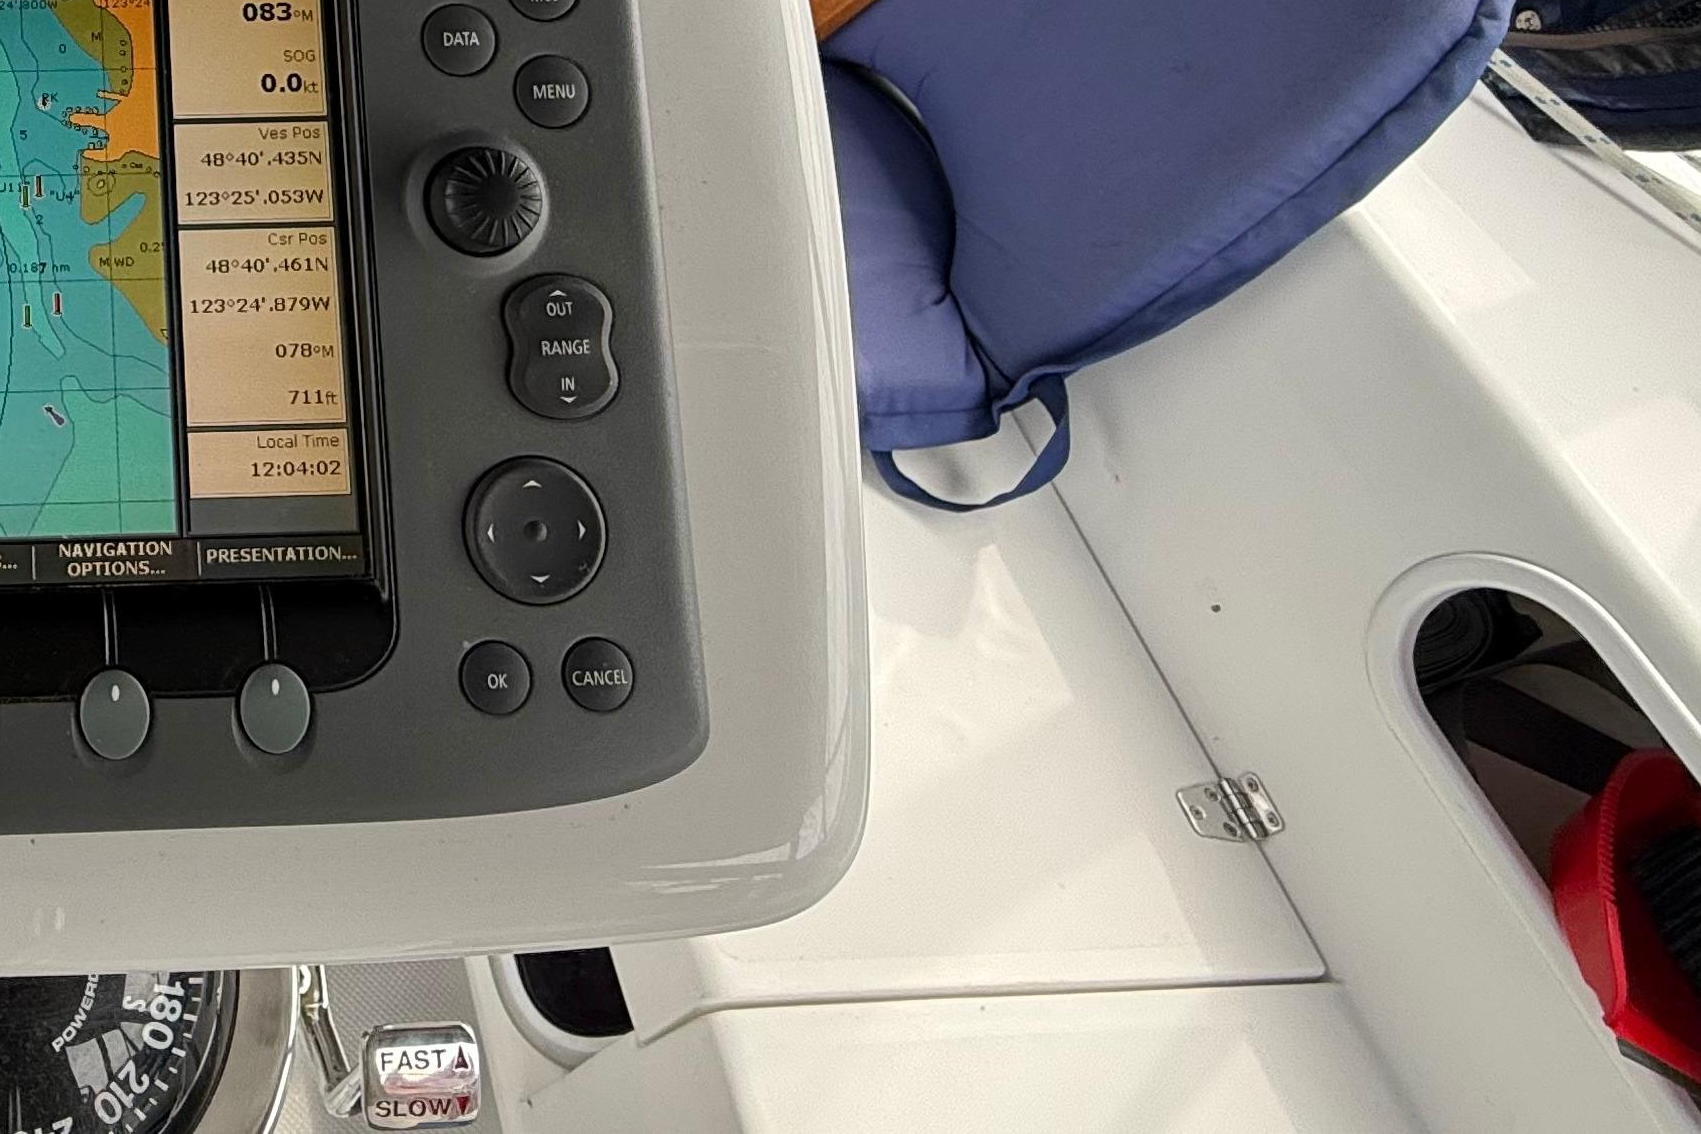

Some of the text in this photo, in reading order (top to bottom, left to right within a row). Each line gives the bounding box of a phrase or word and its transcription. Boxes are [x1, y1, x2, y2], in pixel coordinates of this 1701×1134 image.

[442, 31, 480, 47] DATA
[282, 49, 317, 63] SOG
[532, 84, 576, 100] MENU
[258, 126, 321, 140] Ves Pos
[267, 232, 328, 246] Csr Pos
[545, 301, 574, 317] OUT
[540, 339, 591, 357] RANGE
[560, 377, 576, 392] IN
[256, 433, 341, 450] Local Time
[250, 460, 342, 478] 12:04:02
[57, 541, 174, 560] NAVIGATION
[205, 545, 359, 564] PRESENTATION...
[66, 560, 167, 578] OPTIONS...
[486, 673, 508, 690] OK
[571, 668, 629, 687] CANCEL
[141, 980, 186, 1050] 180
[379, 1048, 448, 1072] FAST
[93, 1059, 151, 1125] 210
[374, 1097, 452, 1118] SLOW
